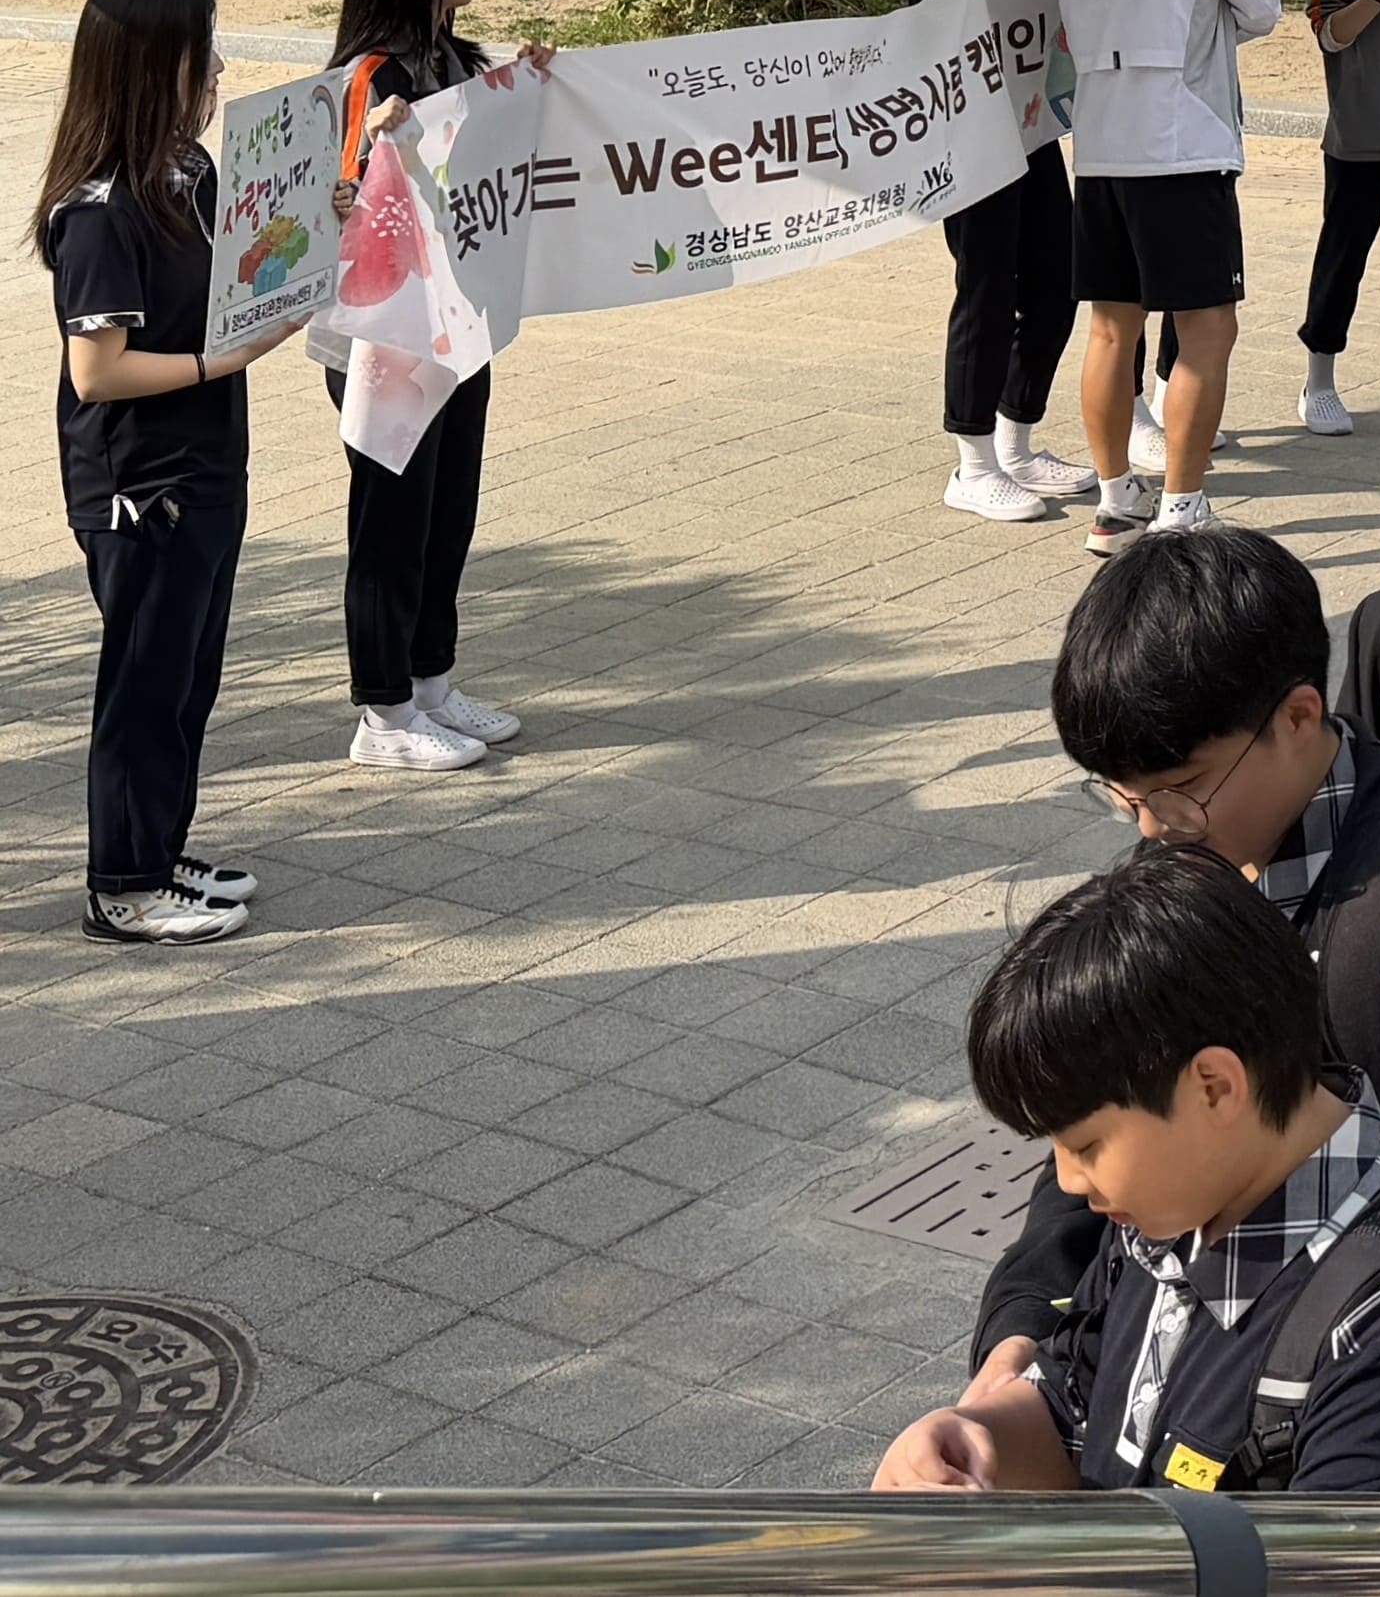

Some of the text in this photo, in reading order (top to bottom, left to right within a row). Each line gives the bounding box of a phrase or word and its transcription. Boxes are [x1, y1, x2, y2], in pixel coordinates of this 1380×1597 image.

[648, 65, 736, 99] "오늘도,
[744, 54, 812, 88] 당신이
[248, 95, 294, 164] 생명은
[222, 155, 316, 235] 사랑입니다.
[448, 152, 581, 262] 찾아가는
[603, 108, 850, 197] Wee센터
[684, 220, 773, 258] 경상남도
[783, 182, 907, 240] 양산교육지원청
[825, 224, 852, 241] OFFICE
[852, 222, 864, 235] OF
[864, 209, 904, 230] EDUCATION
